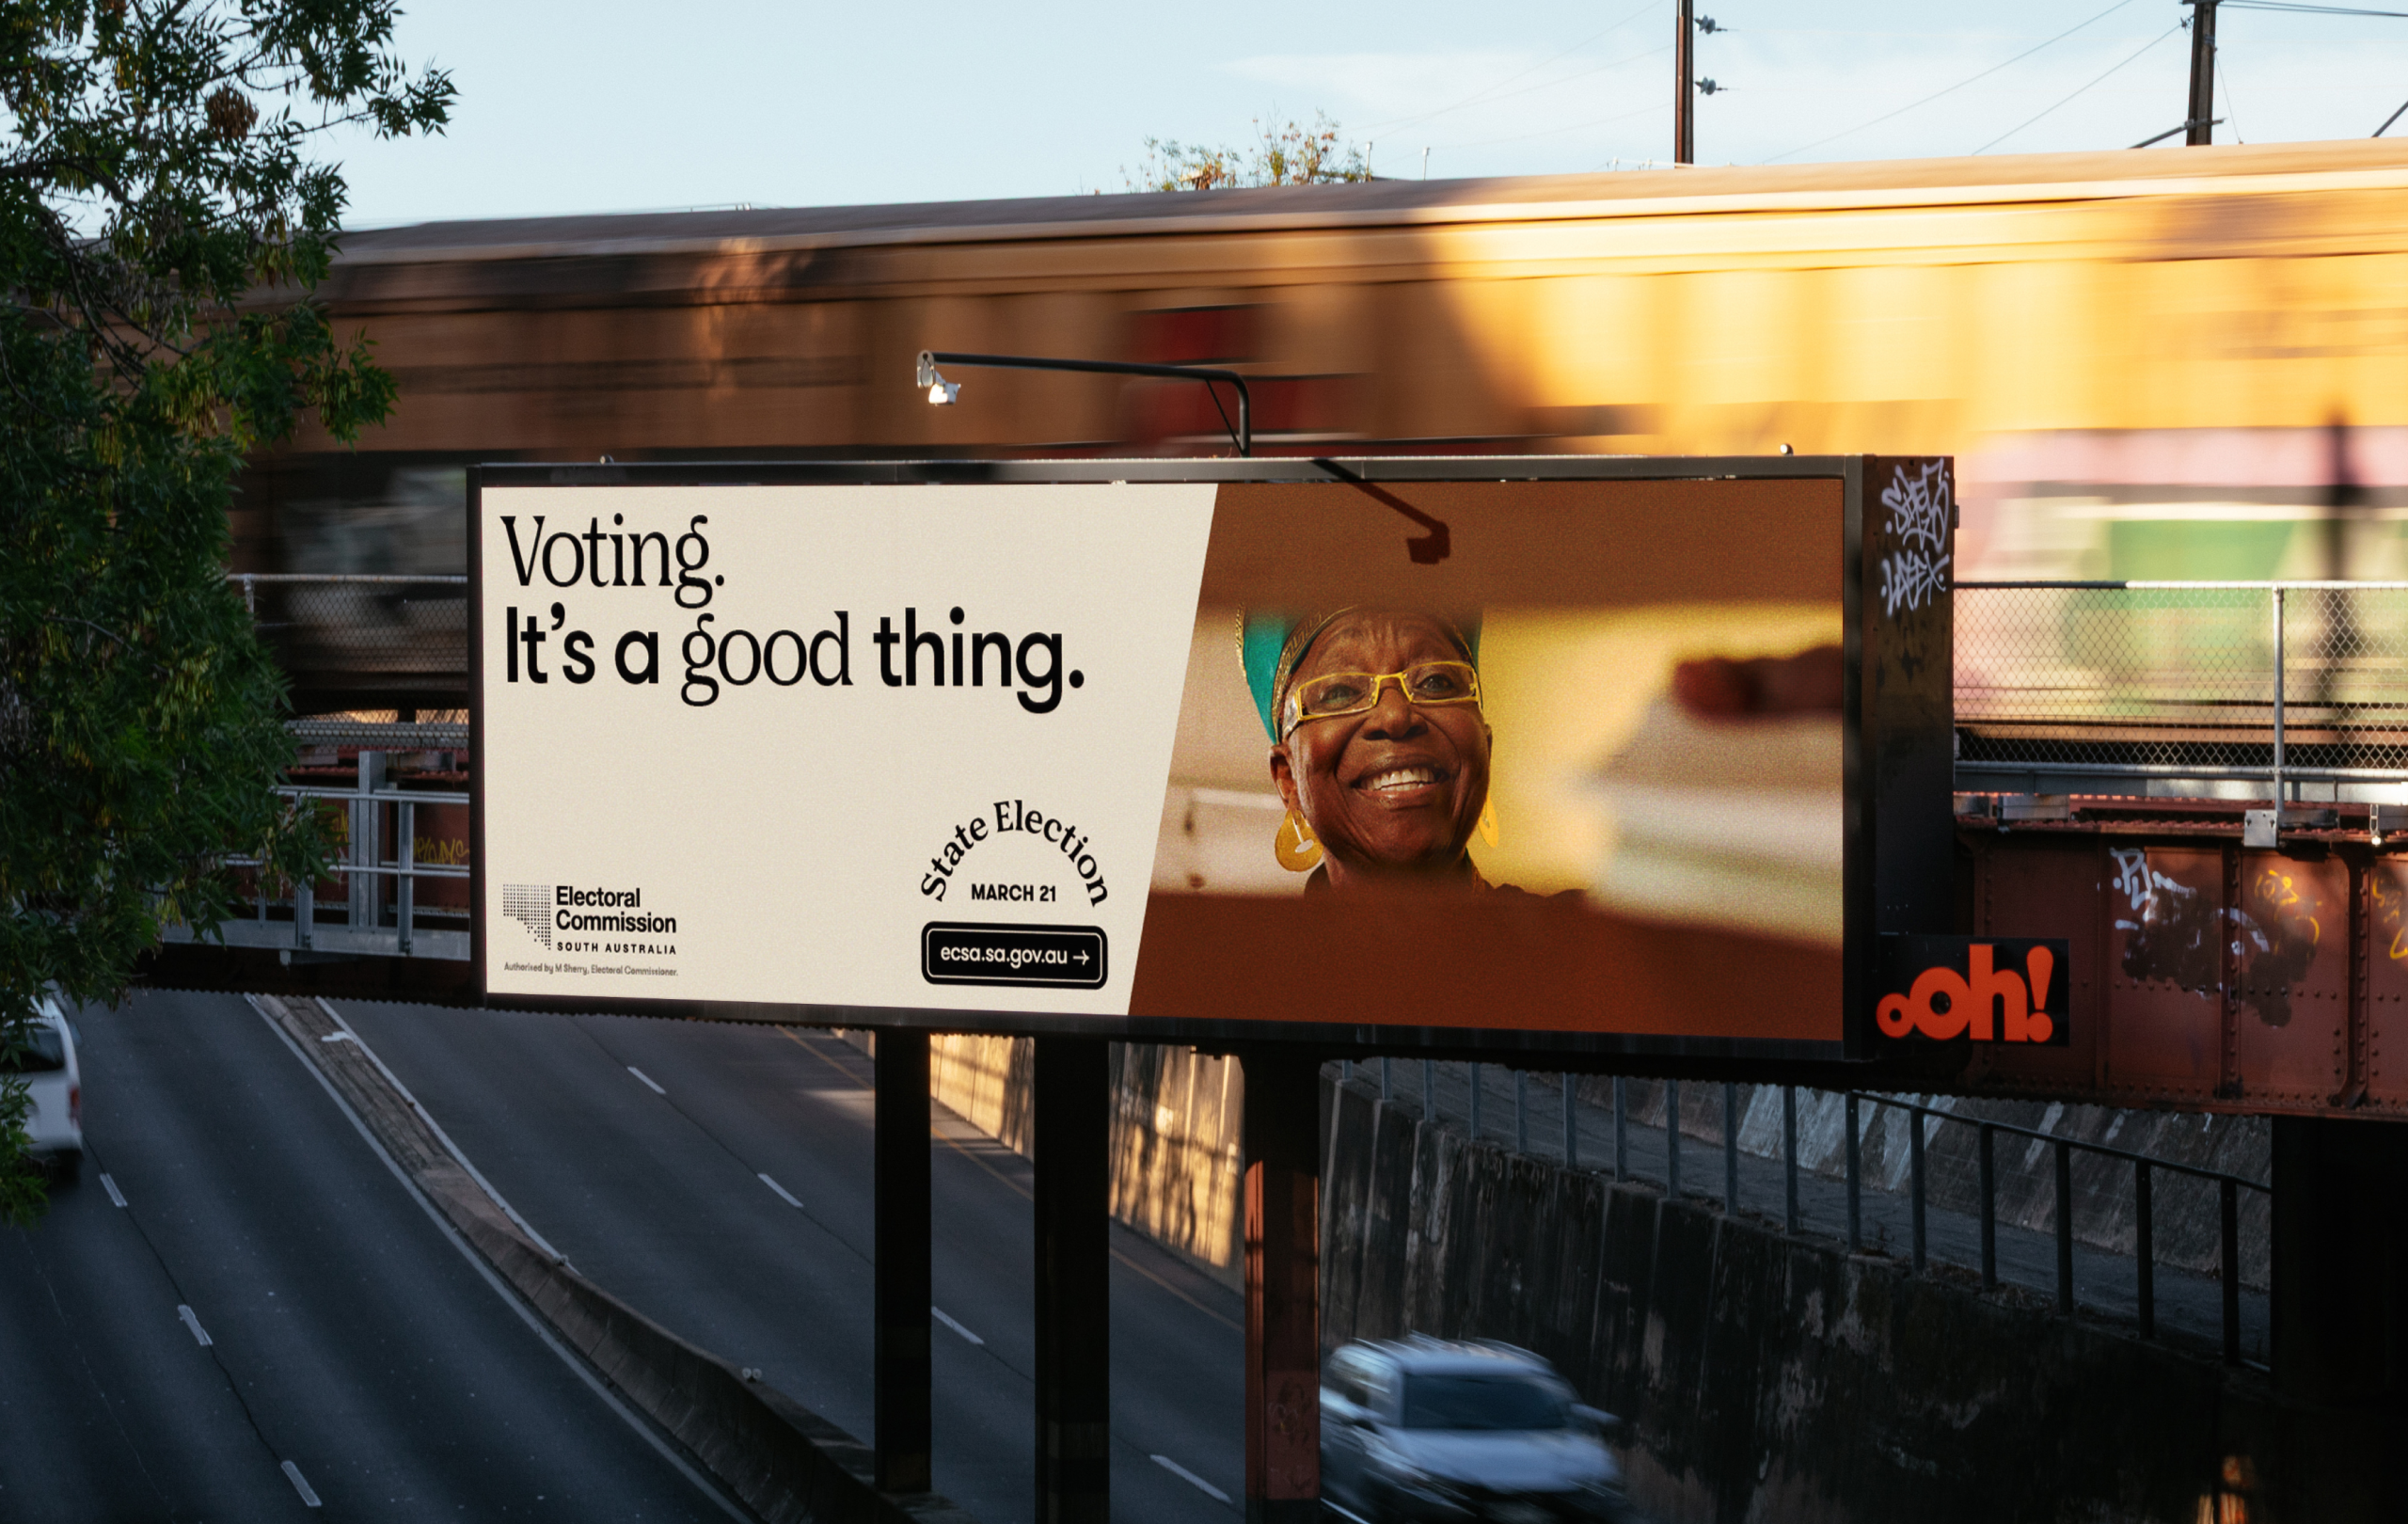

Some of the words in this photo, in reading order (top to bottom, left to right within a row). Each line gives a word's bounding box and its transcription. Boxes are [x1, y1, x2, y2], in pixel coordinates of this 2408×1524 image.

[499, 513, 725, 609] Voting.
[506, 602, 596, 685] It’s
[614, 629, 659, 686] a
[680, 611, 854, 707] good
[873, 606, 1085, 715] thing.
[921, 817, 990, 903] State
[993, 799, 1109, 909] Election
[556, 885, 641, 909] Electoral
[971, 882, 1035, 902] MARCH
[1039, 884, 1057, 903] 21
[555, 909, 677, 934] Commission
[557, 941, 599, 953] SOUTH
[605, 943, 677, 956] AUSTRALIA
[940, 945, 1069, 970] ecsa.sa.gov.au
[503, 961, 543, 973] Authorised
[544, 963, 554, 975] by
[555, 963, 562, 973] M
[563, 963, 590, 976] Sherry,
[591, 964, 624, 975] Electoral
[625, 965, 679, 976] Commissioner.
